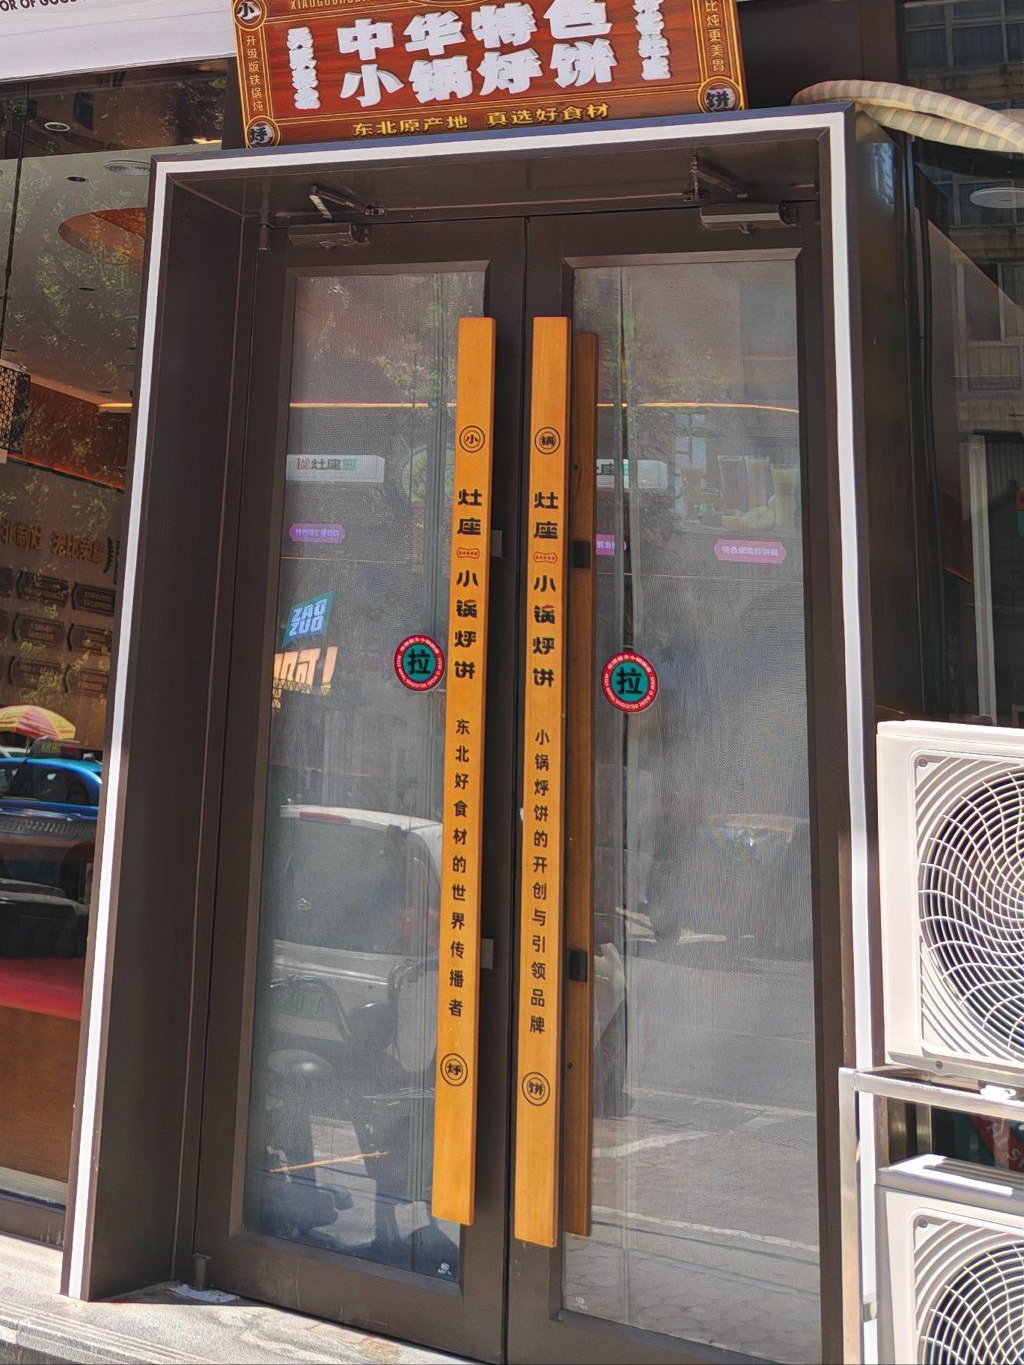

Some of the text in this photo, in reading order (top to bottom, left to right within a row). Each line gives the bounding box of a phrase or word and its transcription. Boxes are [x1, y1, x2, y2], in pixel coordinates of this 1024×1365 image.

[237, 3, 255, 18] 小
[246, 35, 263, 111] 升级版铁锅炖
[338, 37, 618, 108] 小锅烀饼
[352, 102, 609, 137] 东北原产地 真选好食材
[457, 489, 482, 536] 灶座
[533, 492, 558, 540] 灶座
[455, 570, 478, 680] 小锅烀饼
[533, 575, 556, 686] 小锅烀饼
[408, 649, 431, 675] 拉
[616, 667, 643, 694] 拉
[448, 718, 470, 1017] 东北好食材的世界传播者
[529, 729, 550, 1034] 小锅烀饼的开创与引领品牌
